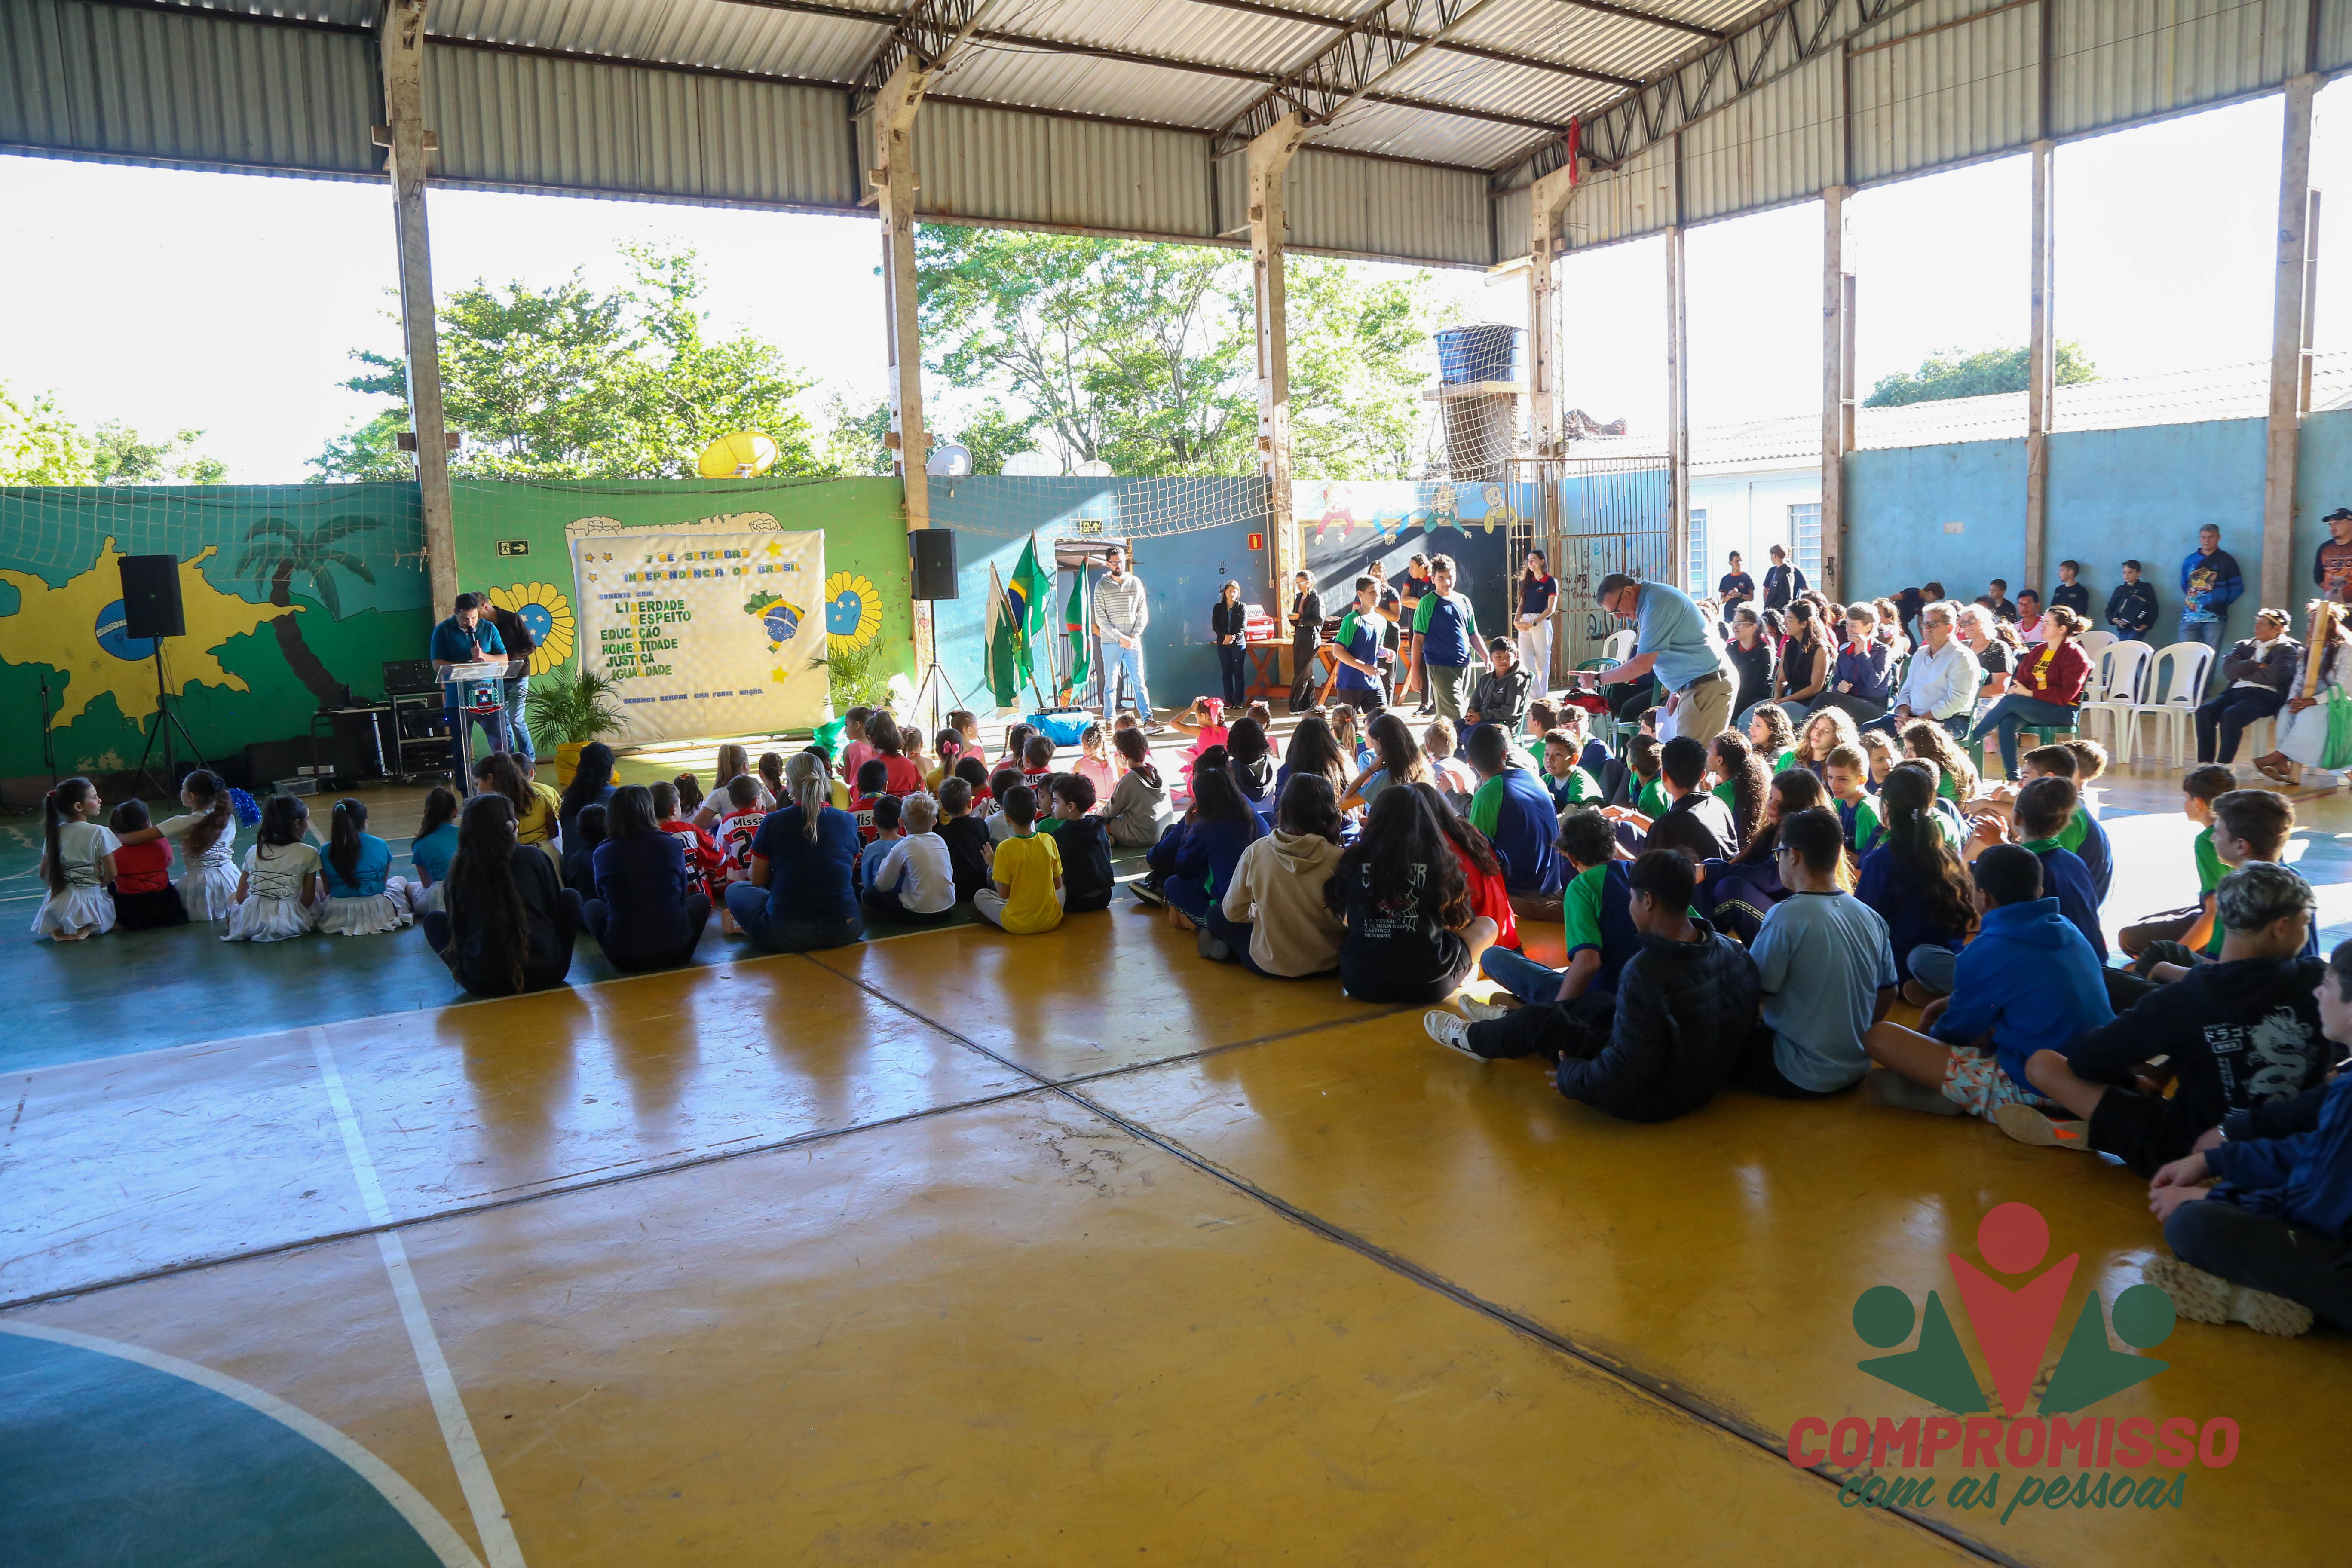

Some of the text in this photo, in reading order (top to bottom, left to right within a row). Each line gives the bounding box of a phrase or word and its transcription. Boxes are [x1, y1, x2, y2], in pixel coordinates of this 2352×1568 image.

[645, 548, 750, 564] 7 DE SETEMBRO
[624, 562, 801, 582] INDEPENDÊNCIA DO BRASIL
[615, 600, 685, 613] LIBERDADE
[630, 610, 692, 625] RESPEITO
[600, 625, 661, 641] EDUCAÇÃO
[602, 638, 678, 655] HONESTIDADE
[606, 652, 655, 668] JUSTIÇA
[612, 665, 673, 680] IGUALDADE
[1025, 774, 1041, 785] Mis
[733, 818, 764, 828] Missa
[857, 814, 871, 826] is
